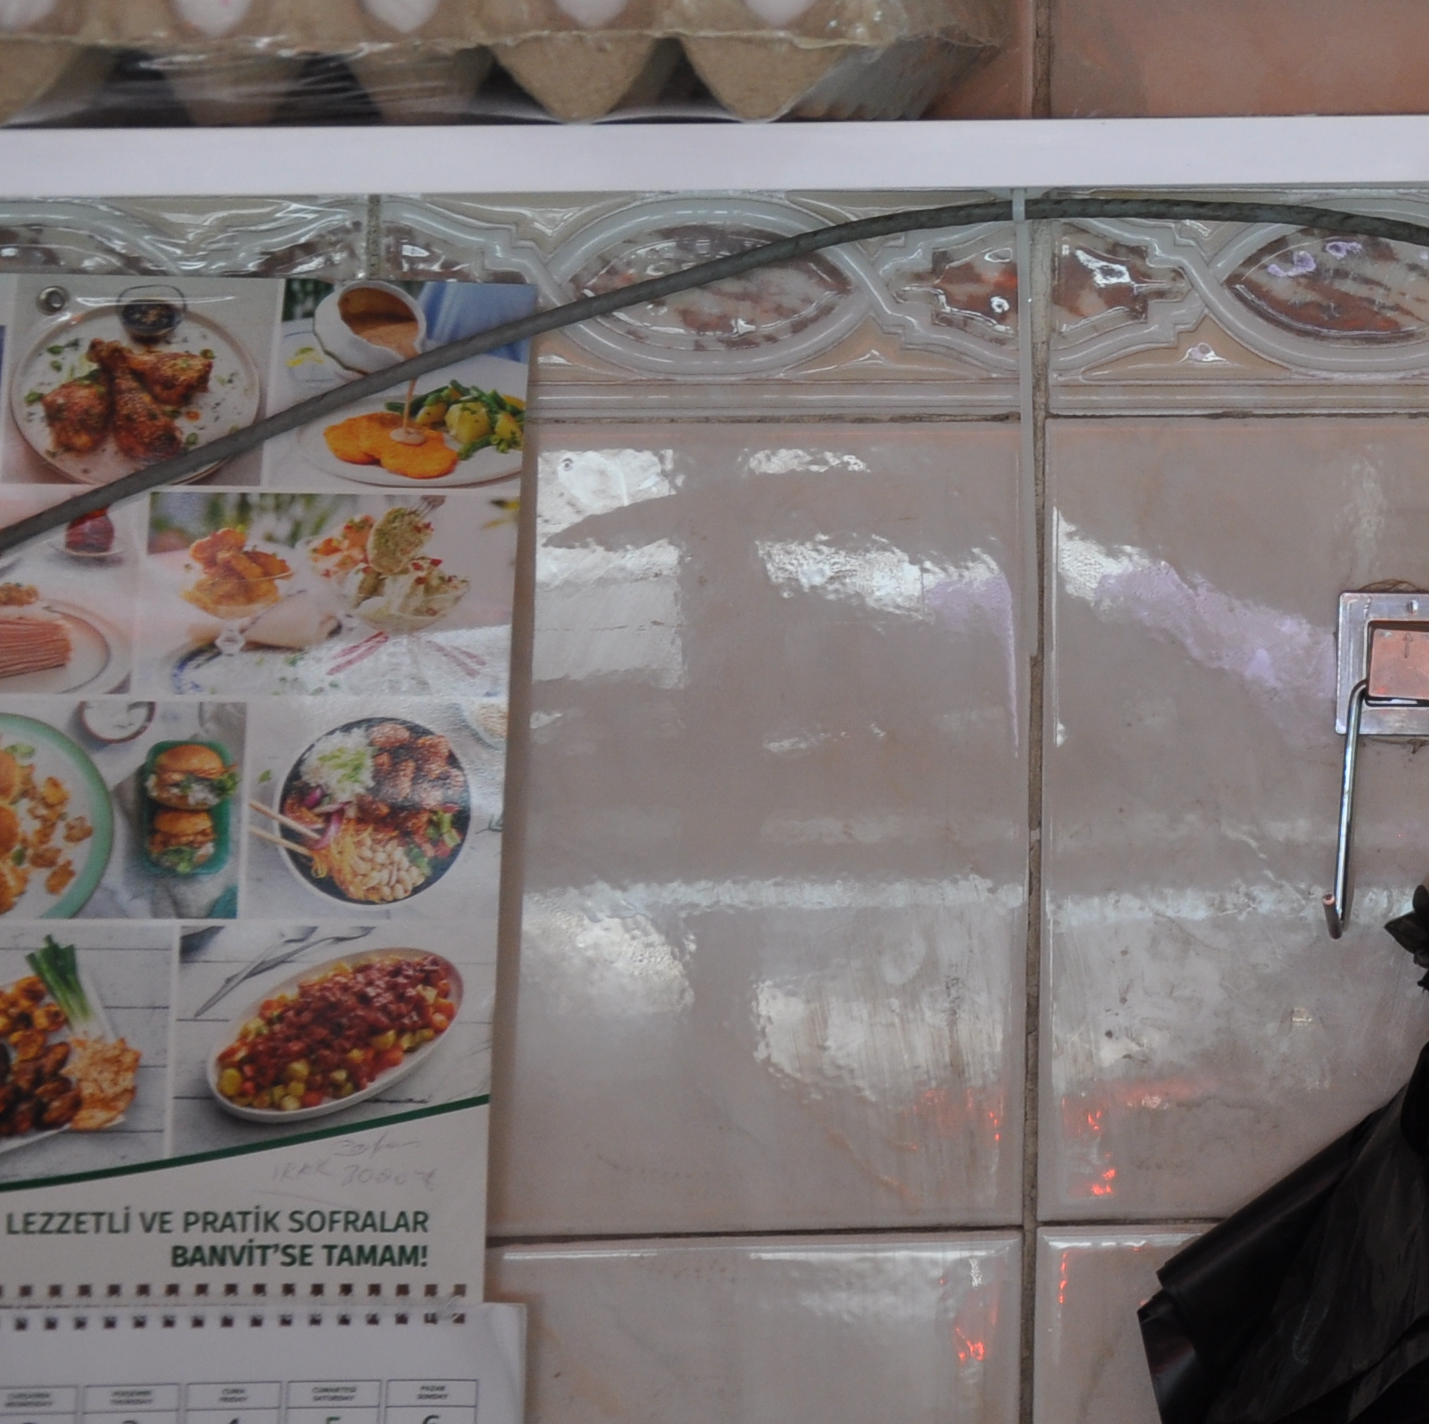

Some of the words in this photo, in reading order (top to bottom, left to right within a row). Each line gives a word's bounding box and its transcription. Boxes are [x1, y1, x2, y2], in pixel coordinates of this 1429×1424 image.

[5, 1205, 131, 1235] LEZZETLİ
[138, 1210, 174, 1234] VE
[182, 1205, 281, 1234] PRATİK
[288, 1209, 431, 1234] SOFRALAR
[321, 1243, 429, 1268] TAMAM!
